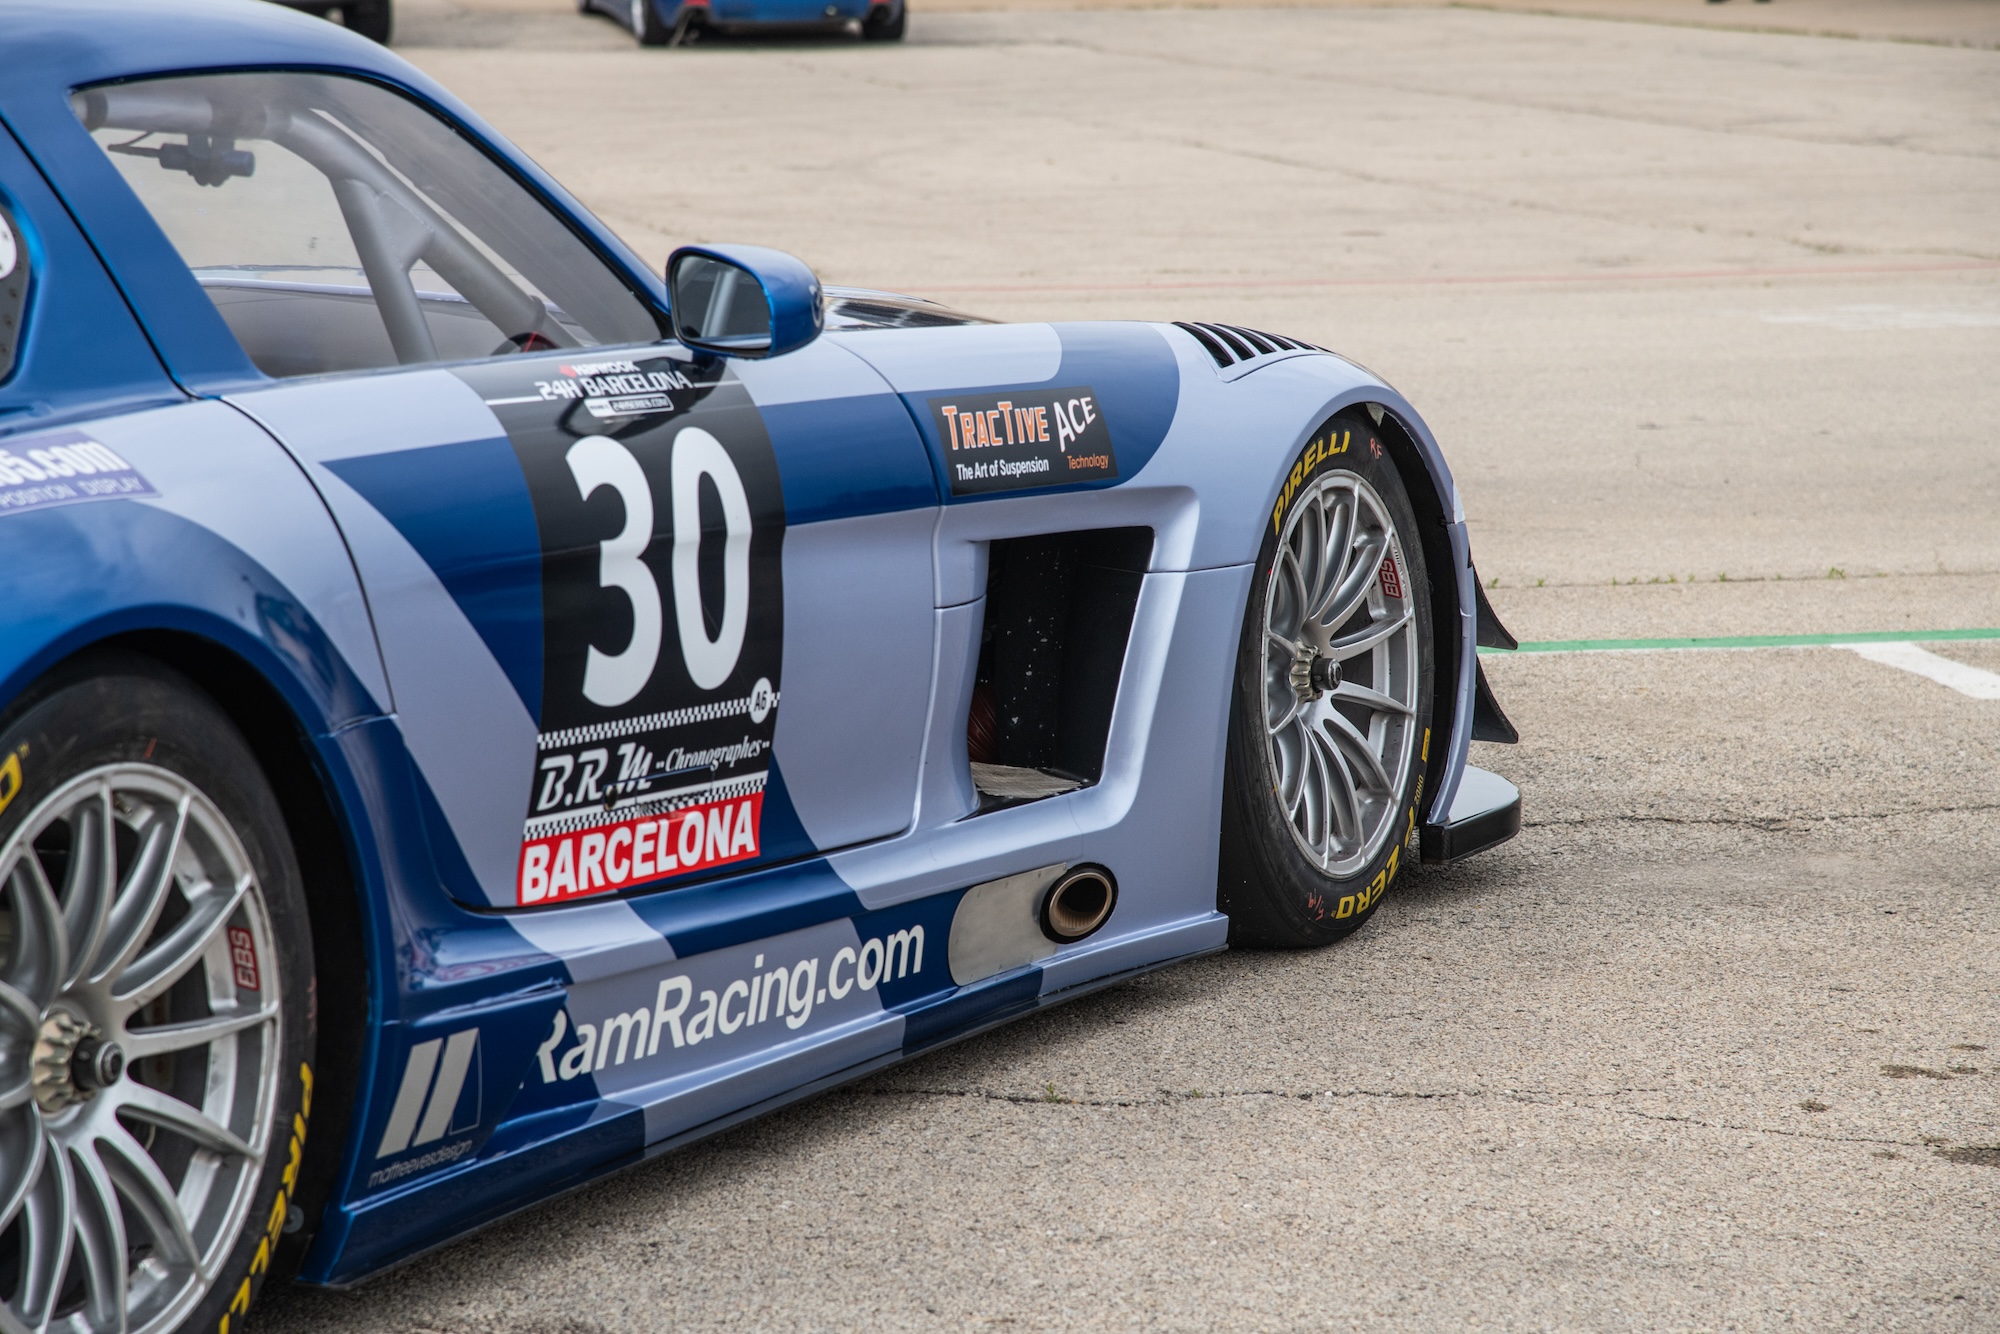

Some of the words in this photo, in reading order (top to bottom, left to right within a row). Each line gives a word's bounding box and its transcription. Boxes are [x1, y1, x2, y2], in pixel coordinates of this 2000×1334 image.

[534, 379, 584, 401] 24H
[579, 370, 694, 398] BARCELONA
[1053, 396, 1097, 453] ACE
[956, 463, 973, 481] The
[974, 461, 989, 479] Art
[989, 459, 1000, 477] of
[1000, 456, 1050, 478] Suspension
[1066, 453, 1109, 470] Technology
[1273, 430, 1351, 536] PIRELLI
[76, 476, 145, 496] DISPLAY
[565, 427, 752, 707] 30
[1380, 560, 1401, 597] BBS
[754, 690, 768, 712] A6
[521, 801, 757, 904] BARCELONA
[1335, 844, 1400, 919] ZERO
[229, 928, 259, 989] BBS
